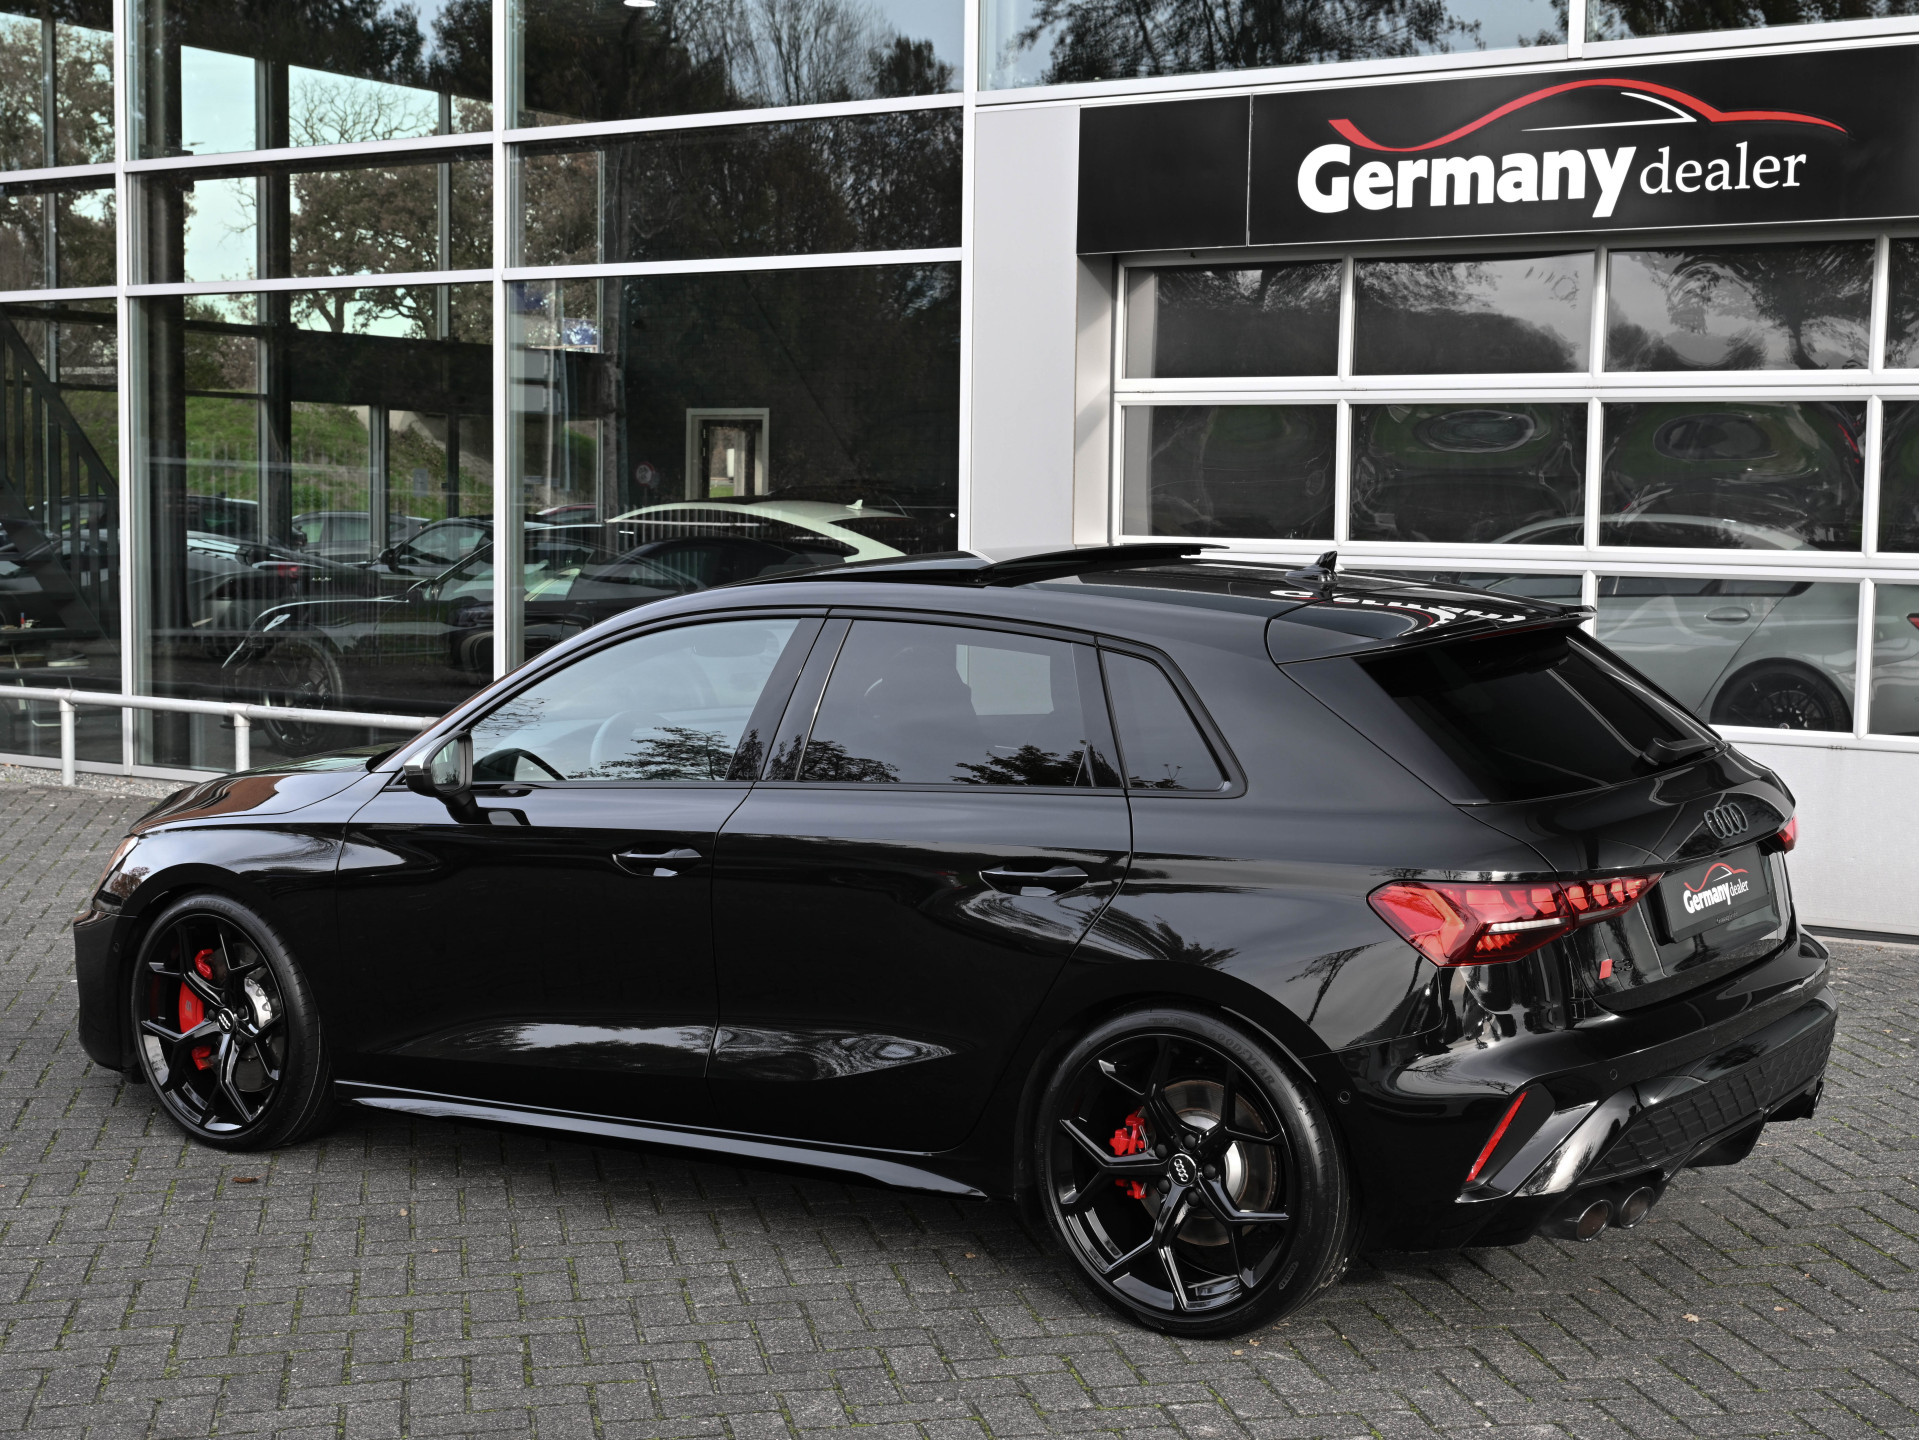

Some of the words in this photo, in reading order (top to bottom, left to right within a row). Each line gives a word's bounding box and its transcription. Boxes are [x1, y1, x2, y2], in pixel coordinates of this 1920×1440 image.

[1297, 144, 1637, 219] Germany
[1640, 140, 1807, 195] dealer
[1683, 881, 1732, 914] Germany
[1729, 878, 1750, 897] dealer
